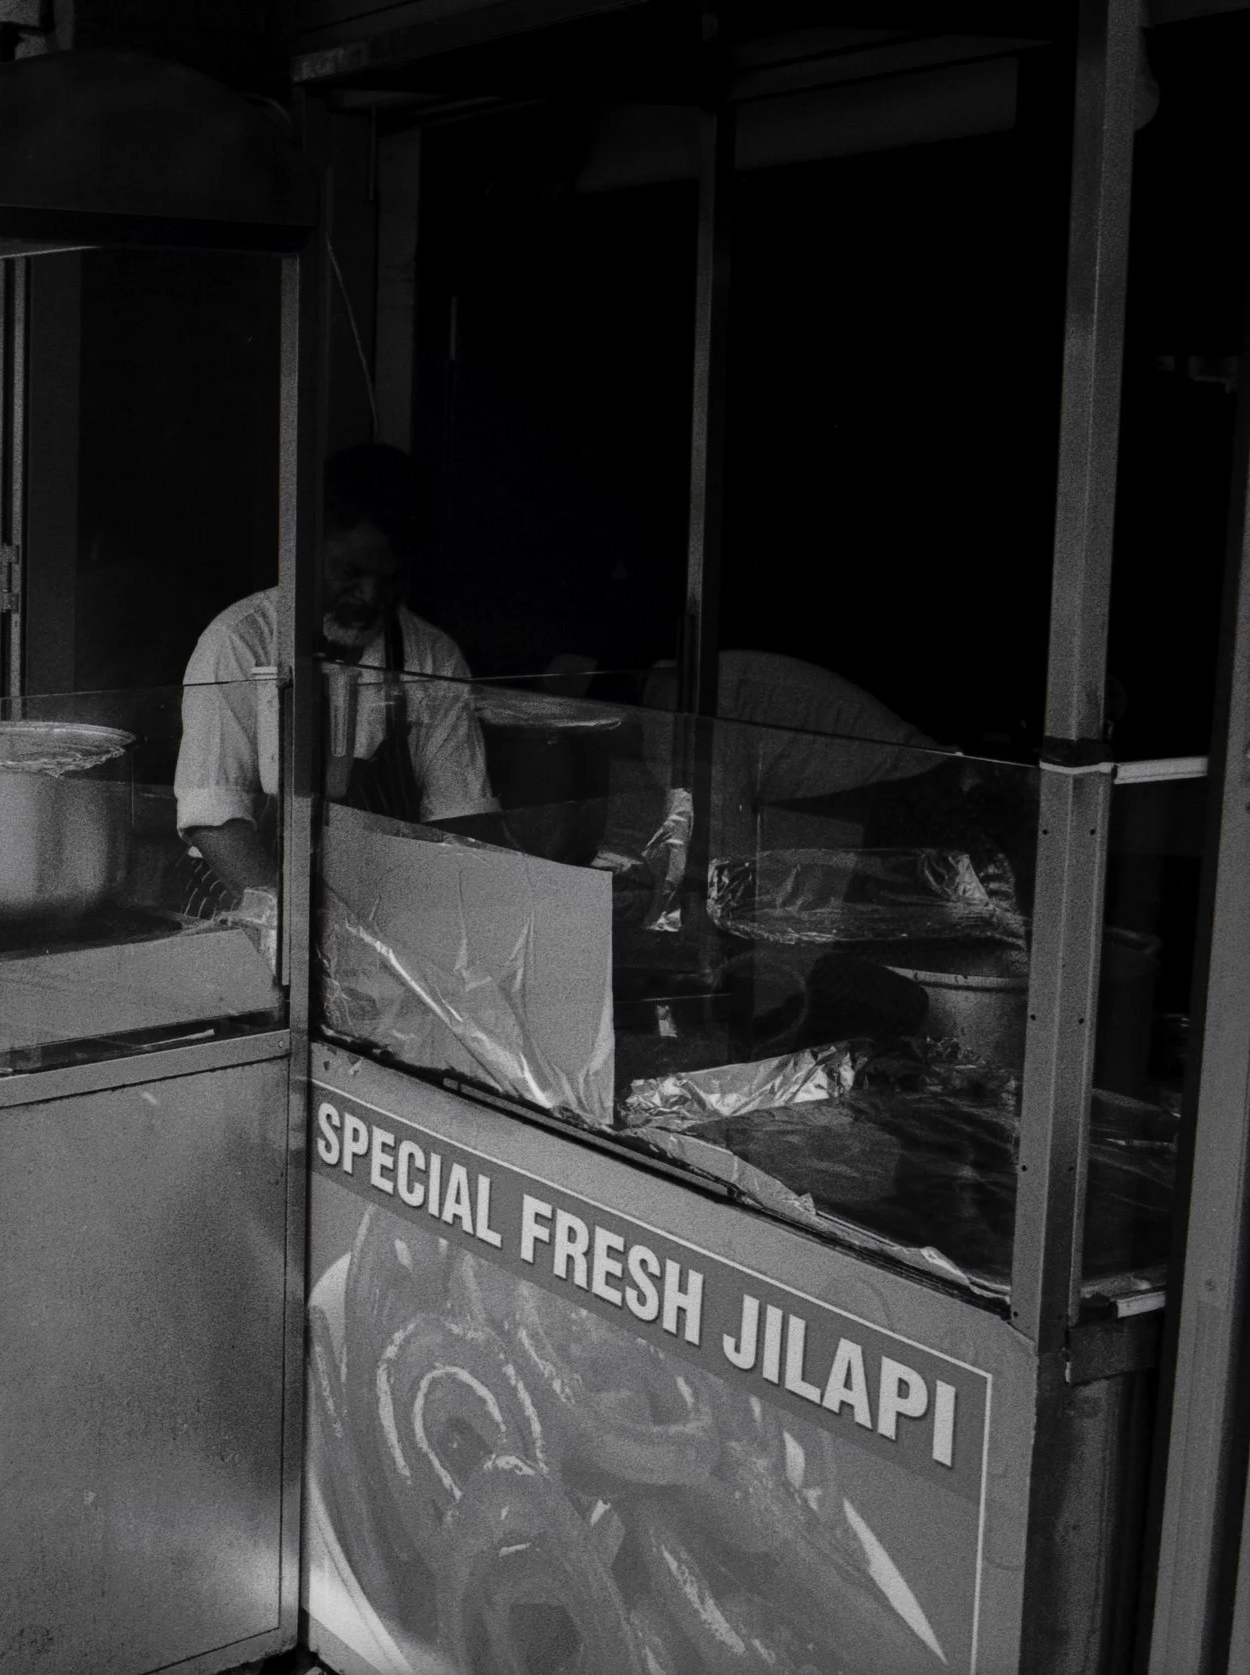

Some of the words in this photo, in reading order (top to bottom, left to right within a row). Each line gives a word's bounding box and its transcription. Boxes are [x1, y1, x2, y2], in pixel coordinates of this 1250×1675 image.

[316, 1102, 503, 1249] SPECIAL
[520, 1193, 705, 1347] FRESH
[722, 1294, 957, 1469] JILAPI
